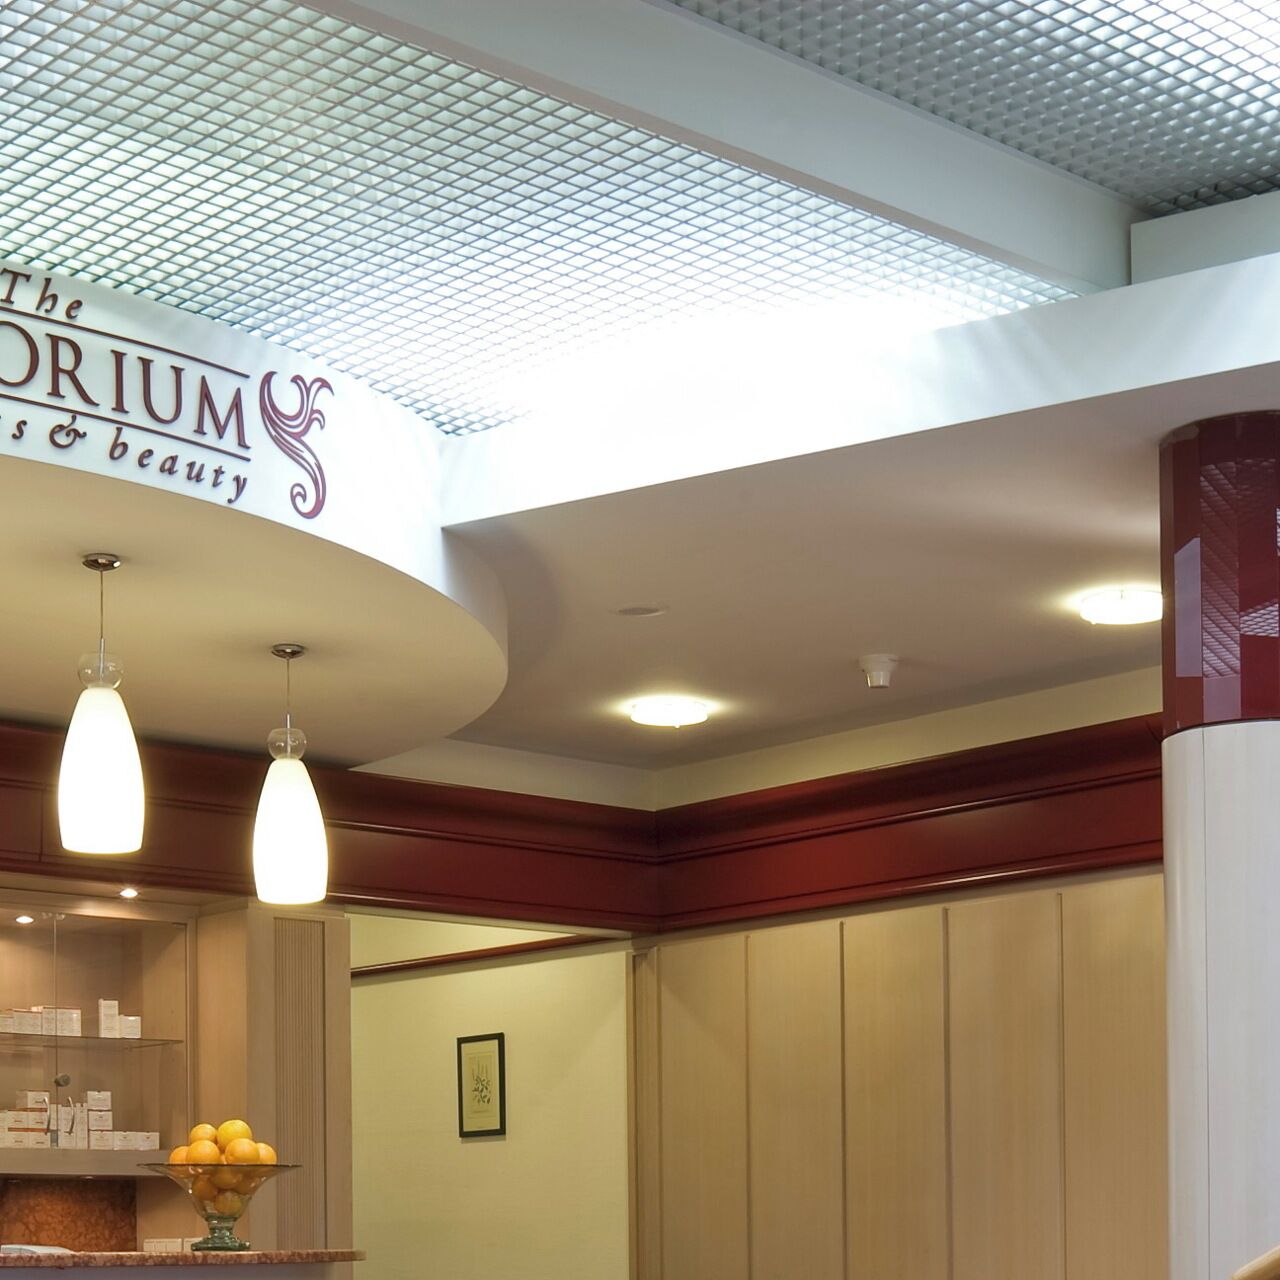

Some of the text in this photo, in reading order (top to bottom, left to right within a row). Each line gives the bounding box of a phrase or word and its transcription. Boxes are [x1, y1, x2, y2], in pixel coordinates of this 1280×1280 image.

[0, 267, 84, 320] The
[49, 413, 87, 449] &
[108, 426, 248, 504] beauty
